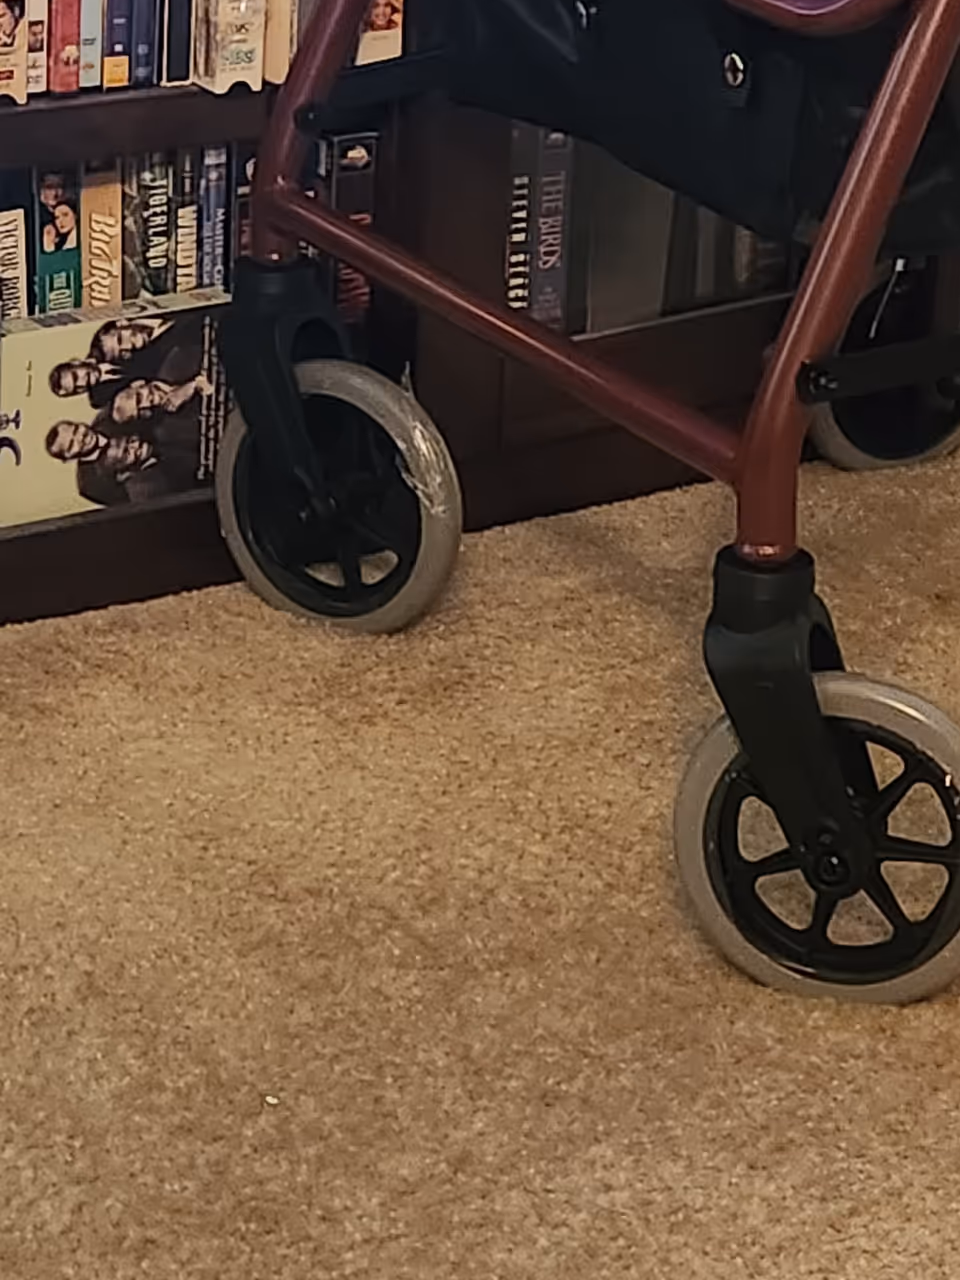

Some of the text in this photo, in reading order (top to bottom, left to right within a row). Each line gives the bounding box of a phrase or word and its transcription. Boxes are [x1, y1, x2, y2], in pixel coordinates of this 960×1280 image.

[541, 170, 565, 213] THE
[143, 179, 169, 269] TIGERLAND
[537, 215, 564, 270] BIRDS
